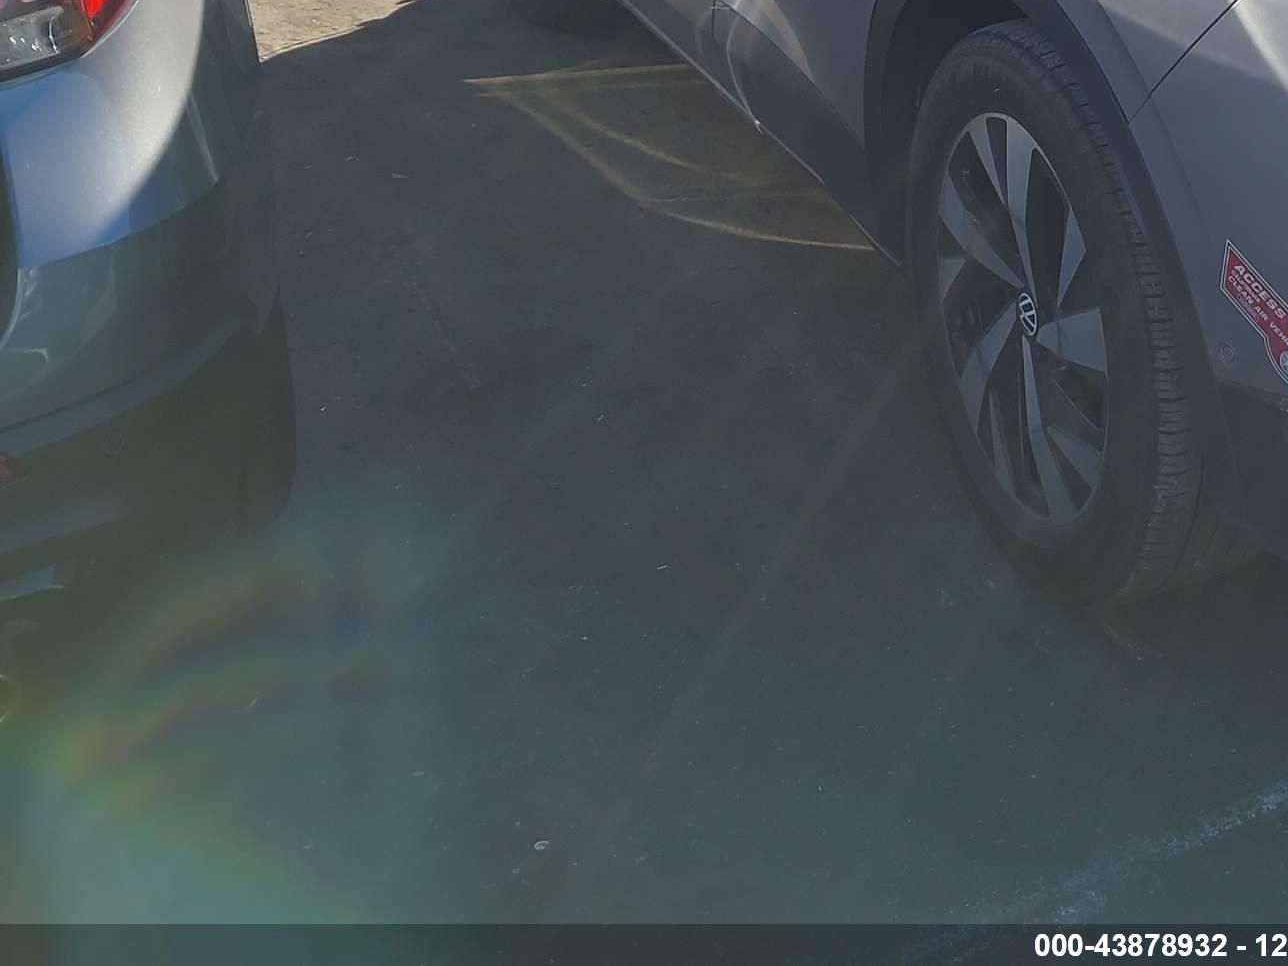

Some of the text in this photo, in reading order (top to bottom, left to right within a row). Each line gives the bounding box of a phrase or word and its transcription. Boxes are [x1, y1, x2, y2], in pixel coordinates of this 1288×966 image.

[1228, 275, 1255, 305] CLEAN
[1253, 305, 1269, 322] AIR
[1233, 265, 1287, 319] ACCESS
